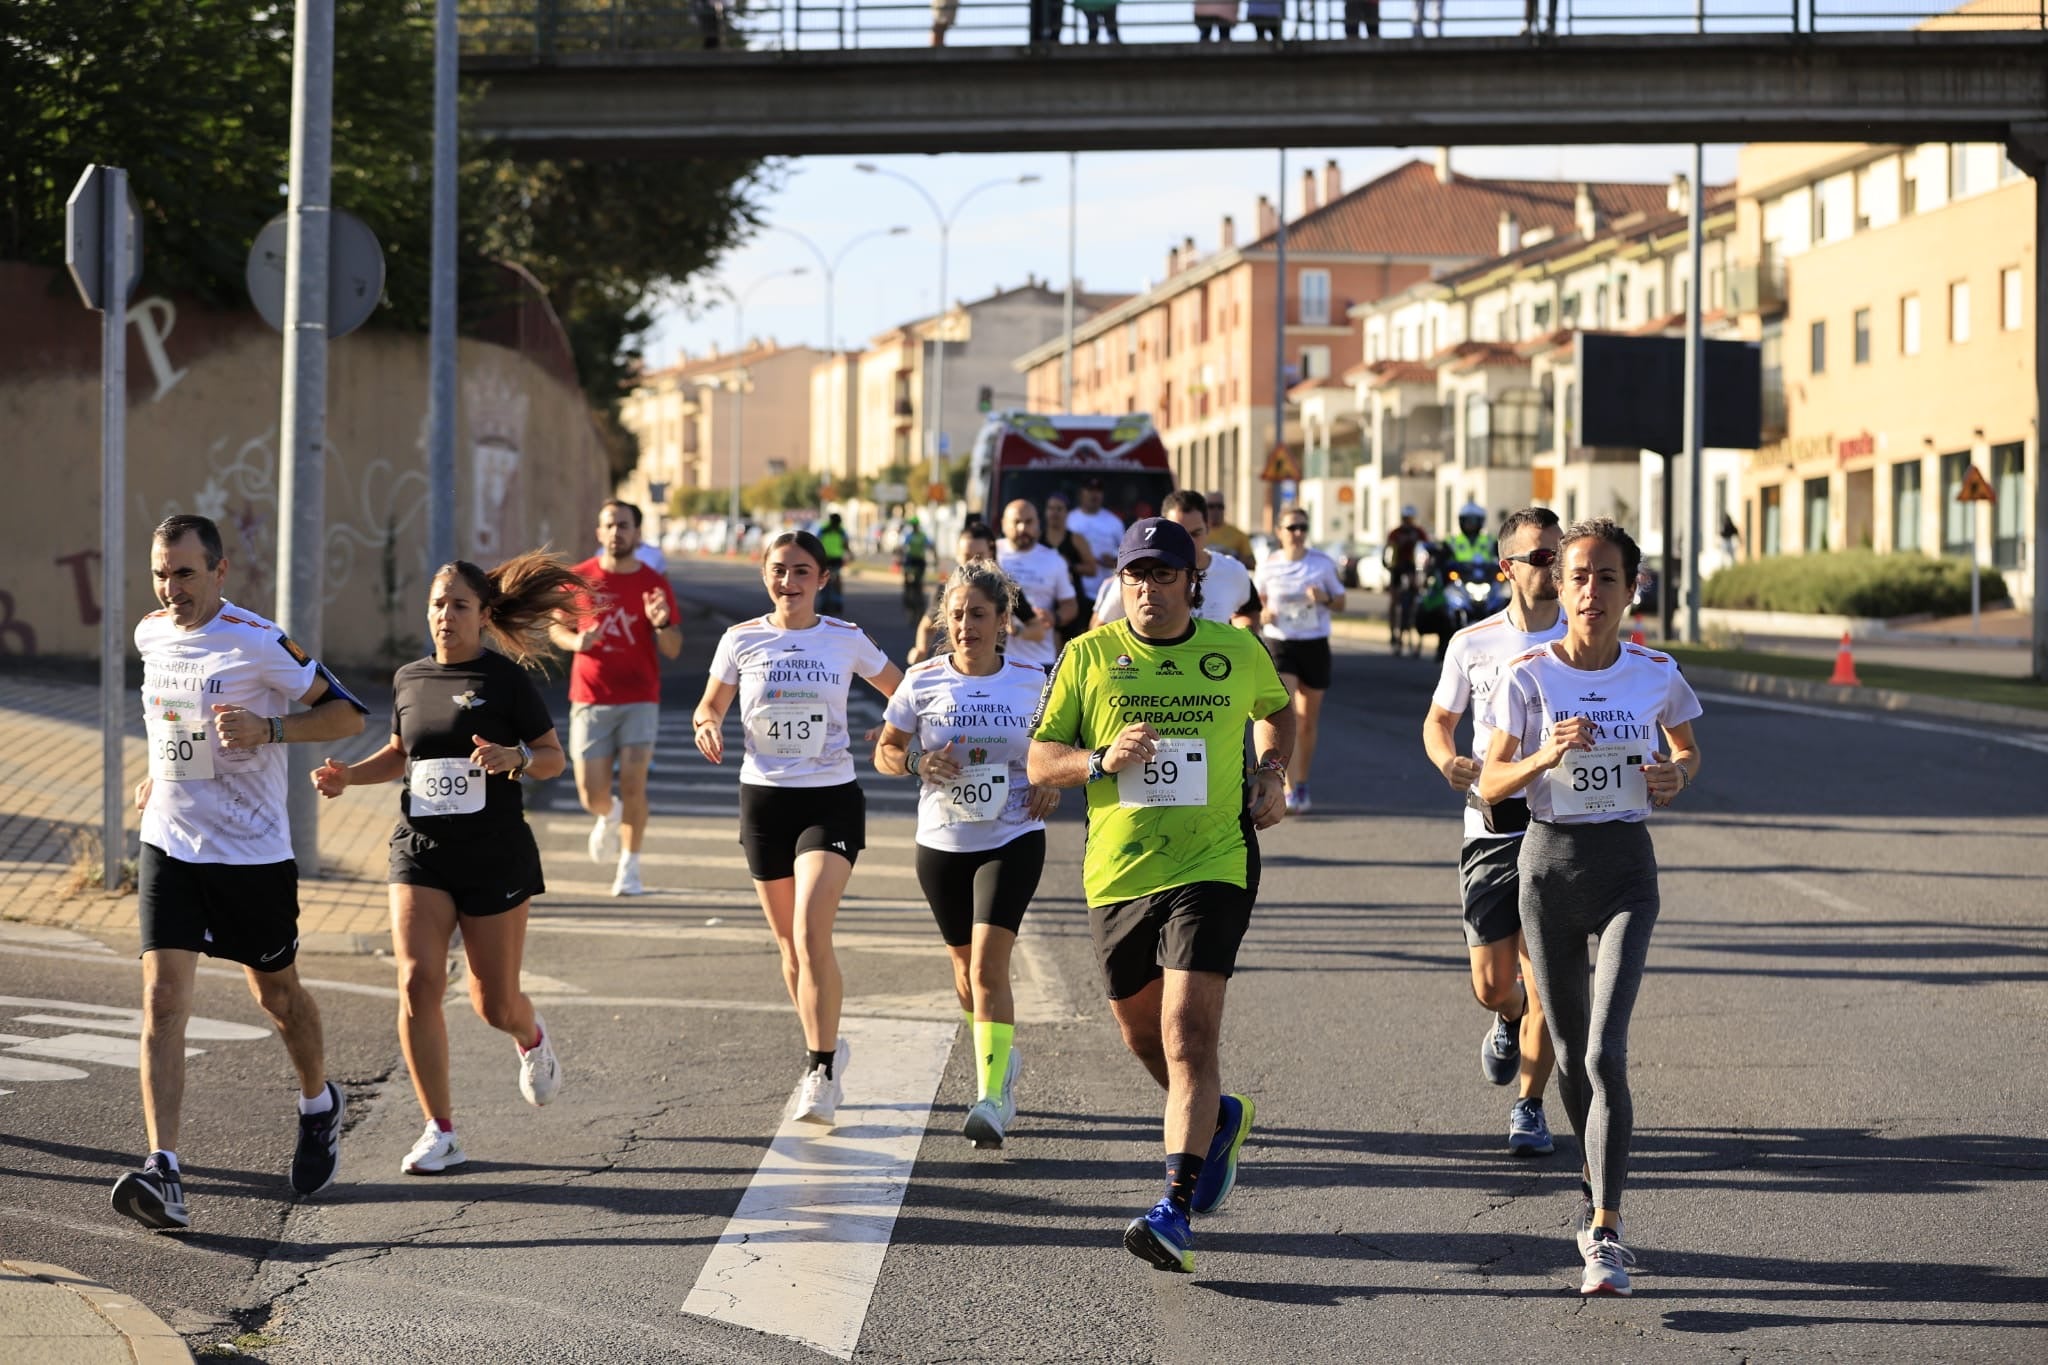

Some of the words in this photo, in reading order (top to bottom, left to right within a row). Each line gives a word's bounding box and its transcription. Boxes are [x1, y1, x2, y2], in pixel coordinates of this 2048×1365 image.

[1144, 527, 1157, 541] 7
[777, 660, 825, 669] CARRERA
[807, 671, 840, 685] CIVIL
[183, 677, 225, 694] CIVIL
[782, 689, 818, 698] Iberdrola
[1109, 695, 1230, 707] CORRECAMINOS
[962, 704, 1012, 713] CARRERA
[1123, 711, 1214, 723] CARBAJOSA
[767, 720, 811, 740] 413
[967, 735, 1008, 744] Iberdrola
[158, 740, 193, 761] 360
[1143, 760, 1178, 785] 59
[1572, 764, 1622, 792] 391
[425, 776, 468, 797] 399
[951, 783, 992, 805] 260
